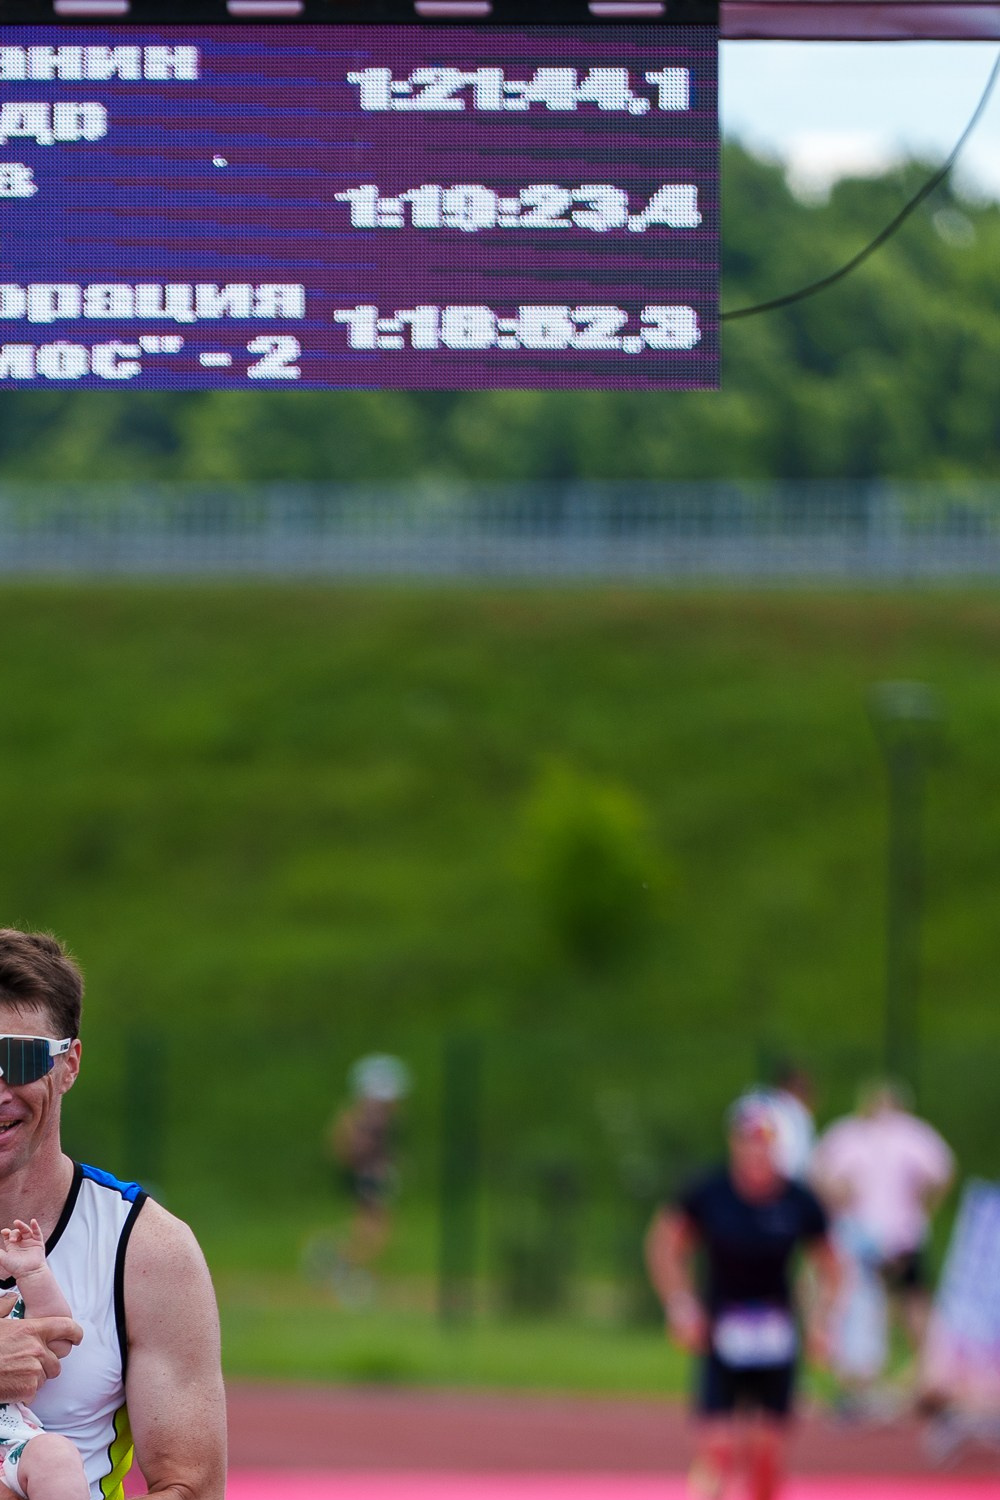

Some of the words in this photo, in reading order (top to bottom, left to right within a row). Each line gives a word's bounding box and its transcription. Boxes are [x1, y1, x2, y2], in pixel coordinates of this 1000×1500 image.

[345, 66, 691, 116] 1:21:44,1
[332, 183, 703, 233] 1:19:23,4
[245, 334, 302, 380] 2
